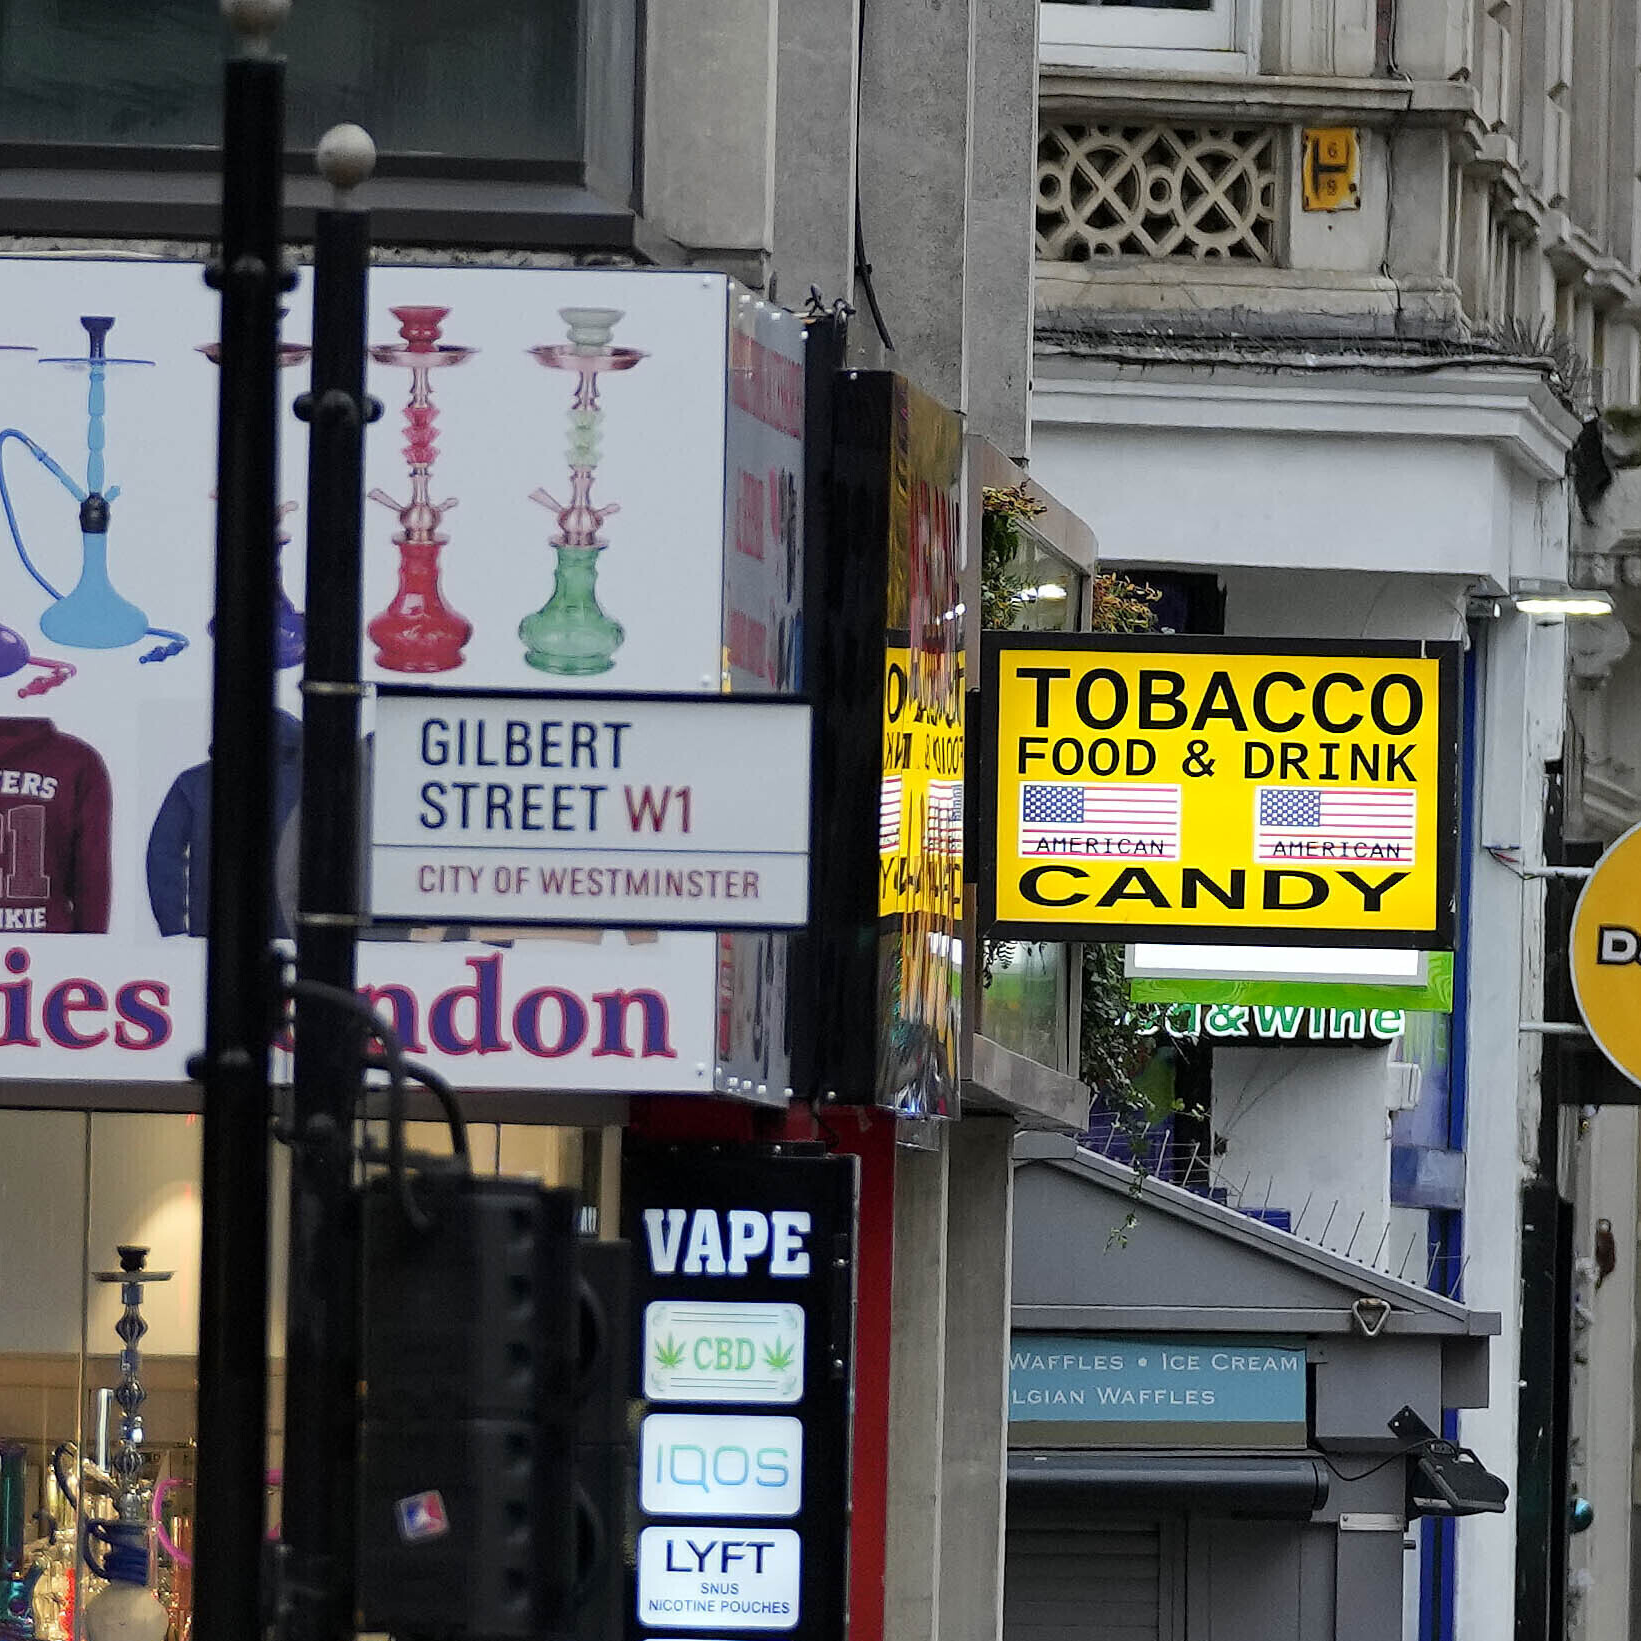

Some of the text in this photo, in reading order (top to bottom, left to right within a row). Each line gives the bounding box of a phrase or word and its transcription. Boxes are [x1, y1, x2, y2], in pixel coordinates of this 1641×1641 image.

[1016, 667, 1423, 736] TOBACCO
[421, 718, 632, 768] GILBERT
[1018, 737, 1418, 781] FOOD & DRINK
[419, 782, 694, 833] STREET W1
[1036, 837, 1164, 855] AMERICAN
[1272, 841, 1400, 859] AMERICAN
[418, 864, 759, 899] CITY OF WESTMINSTER
[1019, 865, 1412, 912] CANDY
[271, 952, 678, 1058] ndon
[643, 1208, 811, 1275] VAPE
[693, 1336, 756, 1371] CBD
[1012, 1389, 1084, 1405] LGIAN
[656, 1444, 789, 1494] IQOS
[666, 1539, 775, 1574] LYFT
[648, 1599, 790, 1614] NICOTINE POUCHES
[700, 1582, 740, 1595] SNUS
